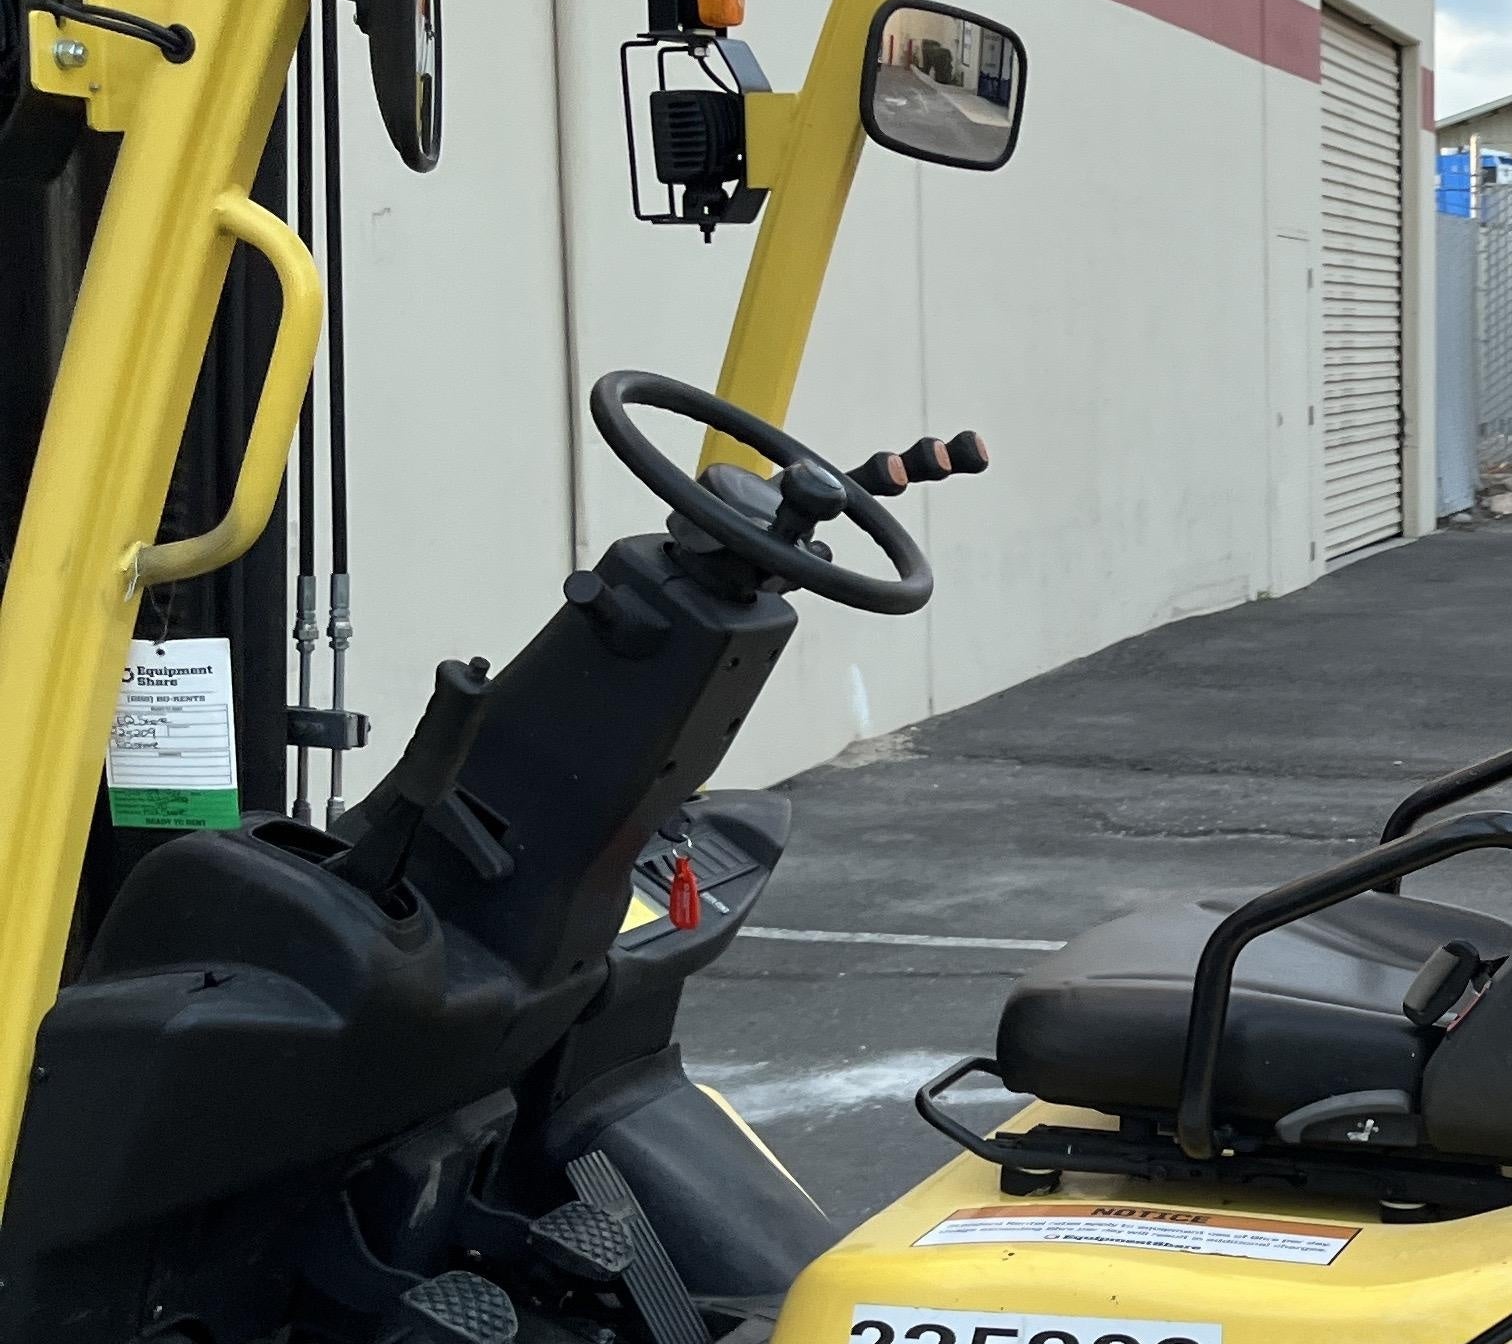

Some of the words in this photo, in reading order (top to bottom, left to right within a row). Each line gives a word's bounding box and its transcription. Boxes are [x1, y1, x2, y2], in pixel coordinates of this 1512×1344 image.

[136, 665, 213, 678] Equipment
[136, 676, 179, 687] Share
[1090, 1207, 1210, 1224] NOTICE
